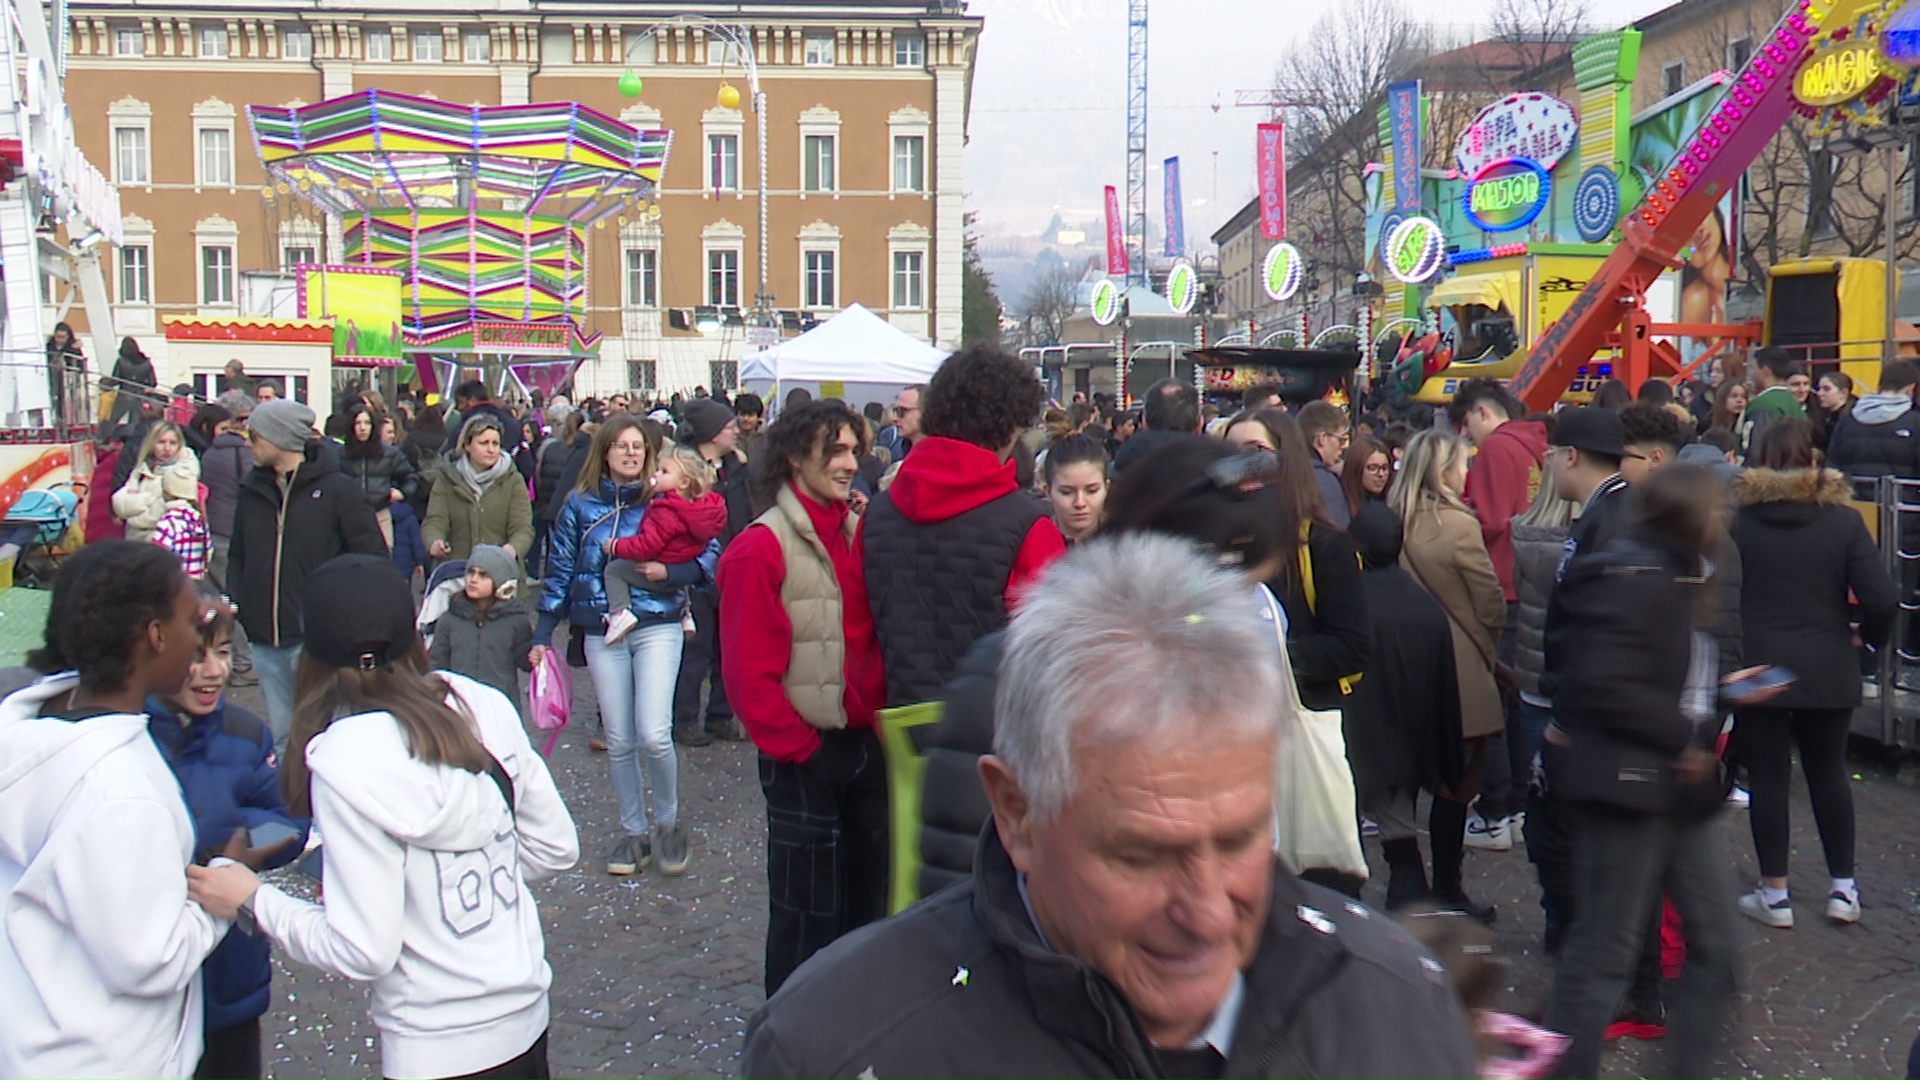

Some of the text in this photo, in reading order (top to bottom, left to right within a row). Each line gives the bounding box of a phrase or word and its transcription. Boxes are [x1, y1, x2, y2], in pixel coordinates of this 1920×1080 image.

[1802, 48, 1880, 98] MAGIC
[1471, 171, 1539, 213] MAJOR
[481, 328, 563, 345] CRAZY FLY
